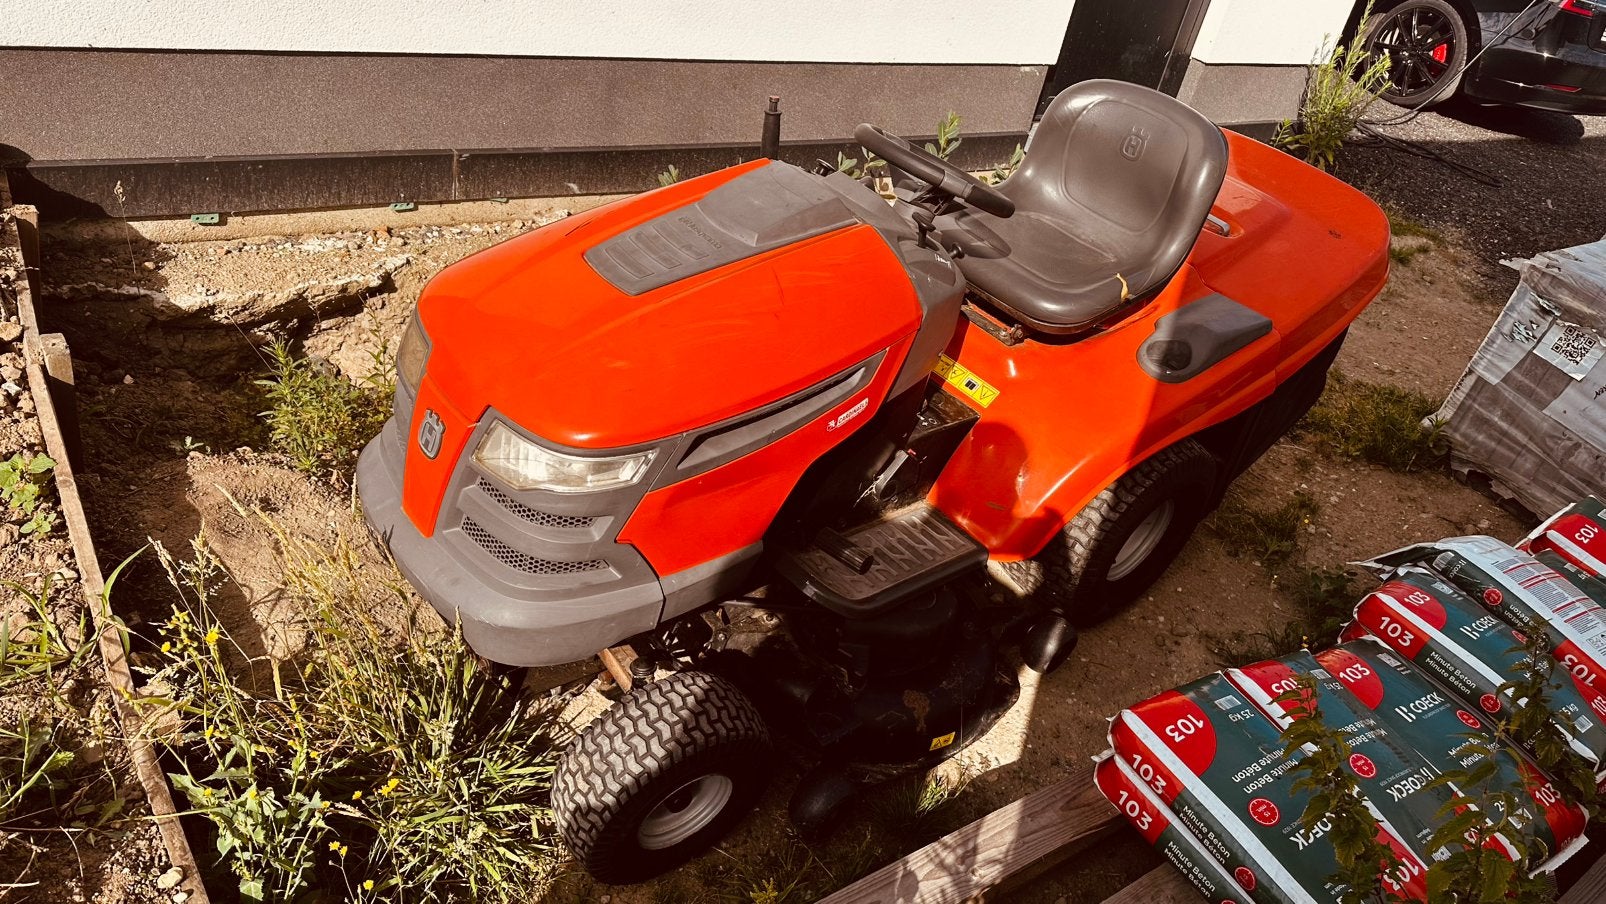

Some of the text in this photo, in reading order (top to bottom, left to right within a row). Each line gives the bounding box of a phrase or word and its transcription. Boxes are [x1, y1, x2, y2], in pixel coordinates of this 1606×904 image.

[1574, 524, 1599, 544] 103
[1404, 591, 1430, 606] 103
[1379, 616, 1414, 647] 103
[1472, 615, 1500, 631] COECK
[1339, 663, 1371, 683] 103
[1425, 657, 1449, 678] Minute
[1449, 674, 1471, 695] Béton
[1430, 651, 1454, 672] Minute
[1454, 668, 1476, 689] Beton
[1559, 653, 1597, 687] 103
[1228, 709, 1255, 722] 25 kg
[1410, 692, 1445, 713] COECK
[1165, 714, 1204, 743] 103
[1132, 754, 1167, 795] 103
[1232, 747, 1286, 783] Minute Béton
[1243, 758, 1298, 794] Minute Beton
[1460, 752, 1485, 768] Minut
[1386, 774, 1427, 802] COECK
[1535, 782, 1560, 806] 103
[1118, 790, 1152, 831] 103
[1178, 812, 1226, 865] Minute Béton
[1182, 805, 1231, 858] Minute Beton
[1164, 848, 1212, 898] Minute Béton
[1168, 841, 1216, 892] Minute Beton
[1383, 857, 1419, 891] 103
